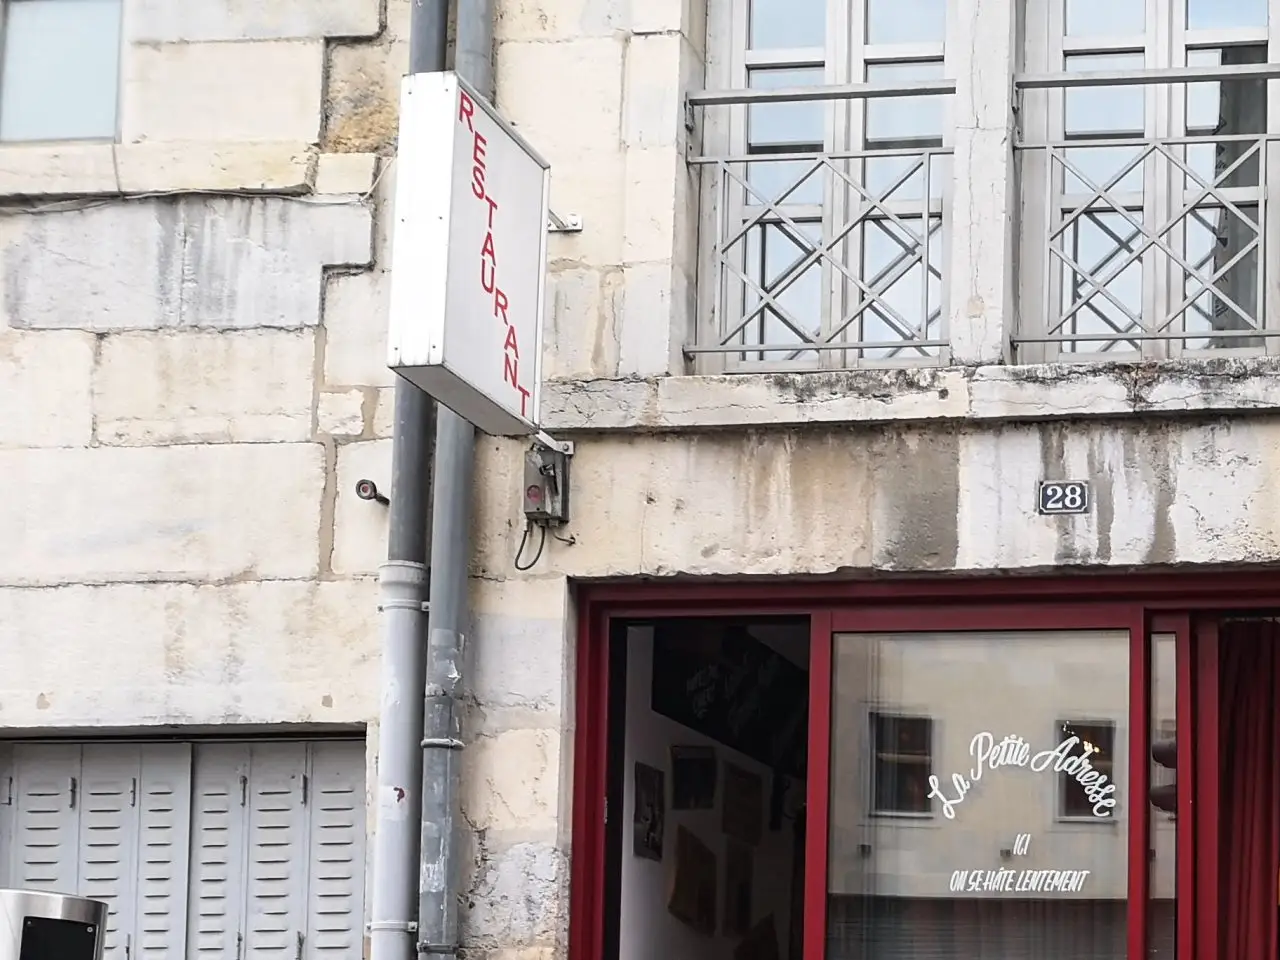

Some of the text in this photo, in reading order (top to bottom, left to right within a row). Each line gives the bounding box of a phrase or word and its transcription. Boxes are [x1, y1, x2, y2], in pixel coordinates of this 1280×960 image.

[459, 90, 530, 418] RESTAURANT
[1046, 485, 1082, 509] 28
[927, 732, 1116, 819] La Petite Adresse
[1013, 833, 1031, 855] ICI
[950, 870, 968, 891] ON
[967, 870, 984, 891] SE
[1015, 870, 1090, 892] LENTEMENT
